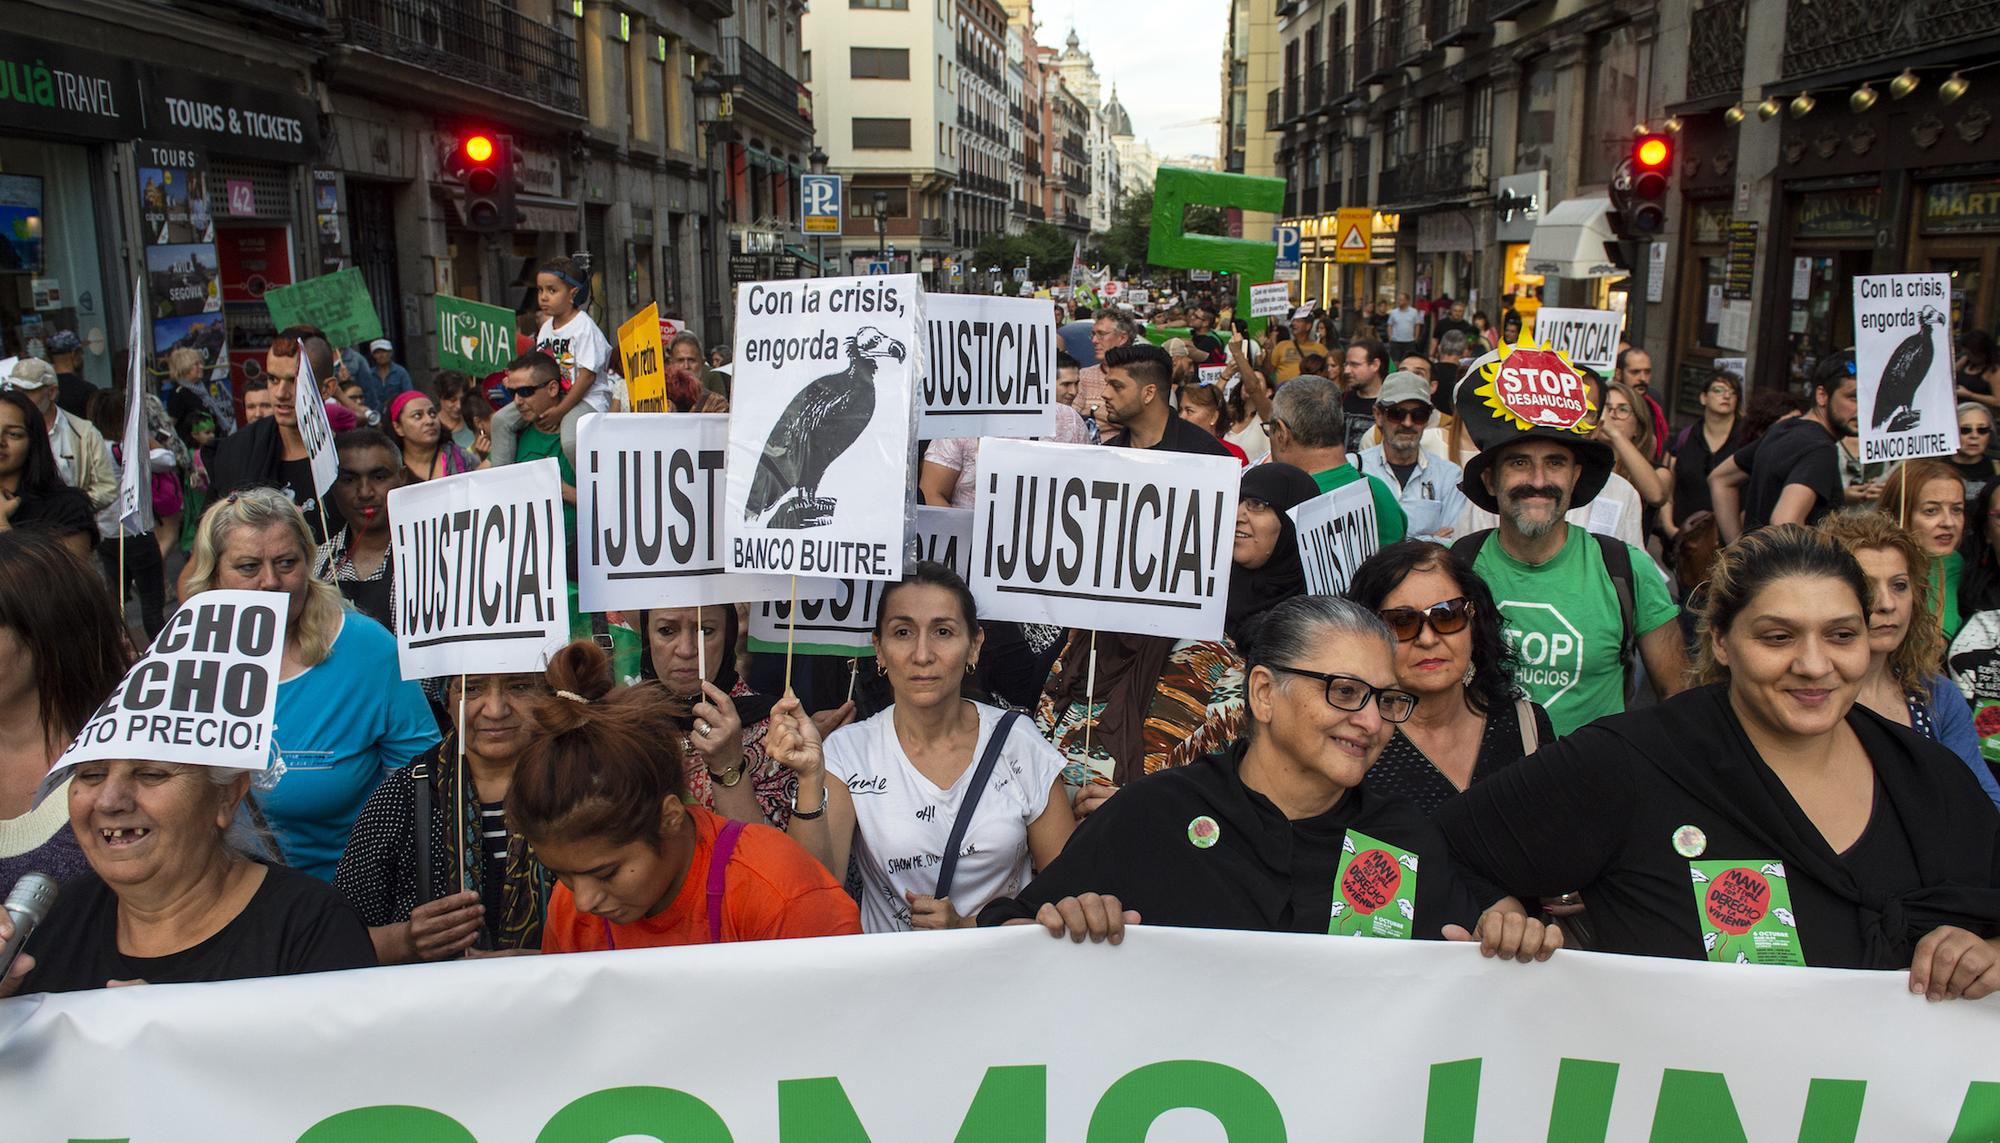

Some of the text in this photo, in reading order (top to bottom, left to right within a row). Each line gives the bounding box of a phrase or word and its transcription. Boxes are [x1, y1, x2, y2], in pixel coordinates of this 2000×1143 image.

[53, 70, 119, 117] TRAVEL
[166, 98, 302, 144] TOURS & TICKETS
[152, 148, 195, 168] TOURS
[233, 186, 252, 213] 42
[810, 183, 833, 215] P
[1277, 228, 1298, 259] P
[951, 265, 959, 276] P
[169, 286, 203, 300] SEGOVIA
[749, 280, 905, 319] Con la crisis,
[1861, 277, 1945, 299] Con la crisis,
[1861, 307, 1915, 333] engorda
[745, 329, 839, 370] engorda
[923, 319, 1049, 407] JUSTICIA!
[1502, 368, 1577, 397] STOP
[1508, 393, 1582, 411] DESAHUCIOS
[1865, 432, 1951, 459] BANCO BUITRE.
[983, 473, 1224, 597] ¡JUSTICIA!
[399, 499, 555, 636] ¡JUSTICIA!
[734, 537, 794, 570] BANCO
[800, 539, 892, 575] BUITRE.
[126, 715, 263, 750] PRECIO!
[888, 857, 912, 874] SHOW
[1369, 851, 1398, 882] MANI
[1343, 879, 1376, 909] VIVIENDA
[1350, 864, 1386, 905] DERECHO
[1723, 881, 1759, 903] FESTIVAL
[1726, 870, 1766, 896] MANI
[1709, 905, 1752, 927] VIVIENDA
[1711, 890, 1761, 919] DERECHO
